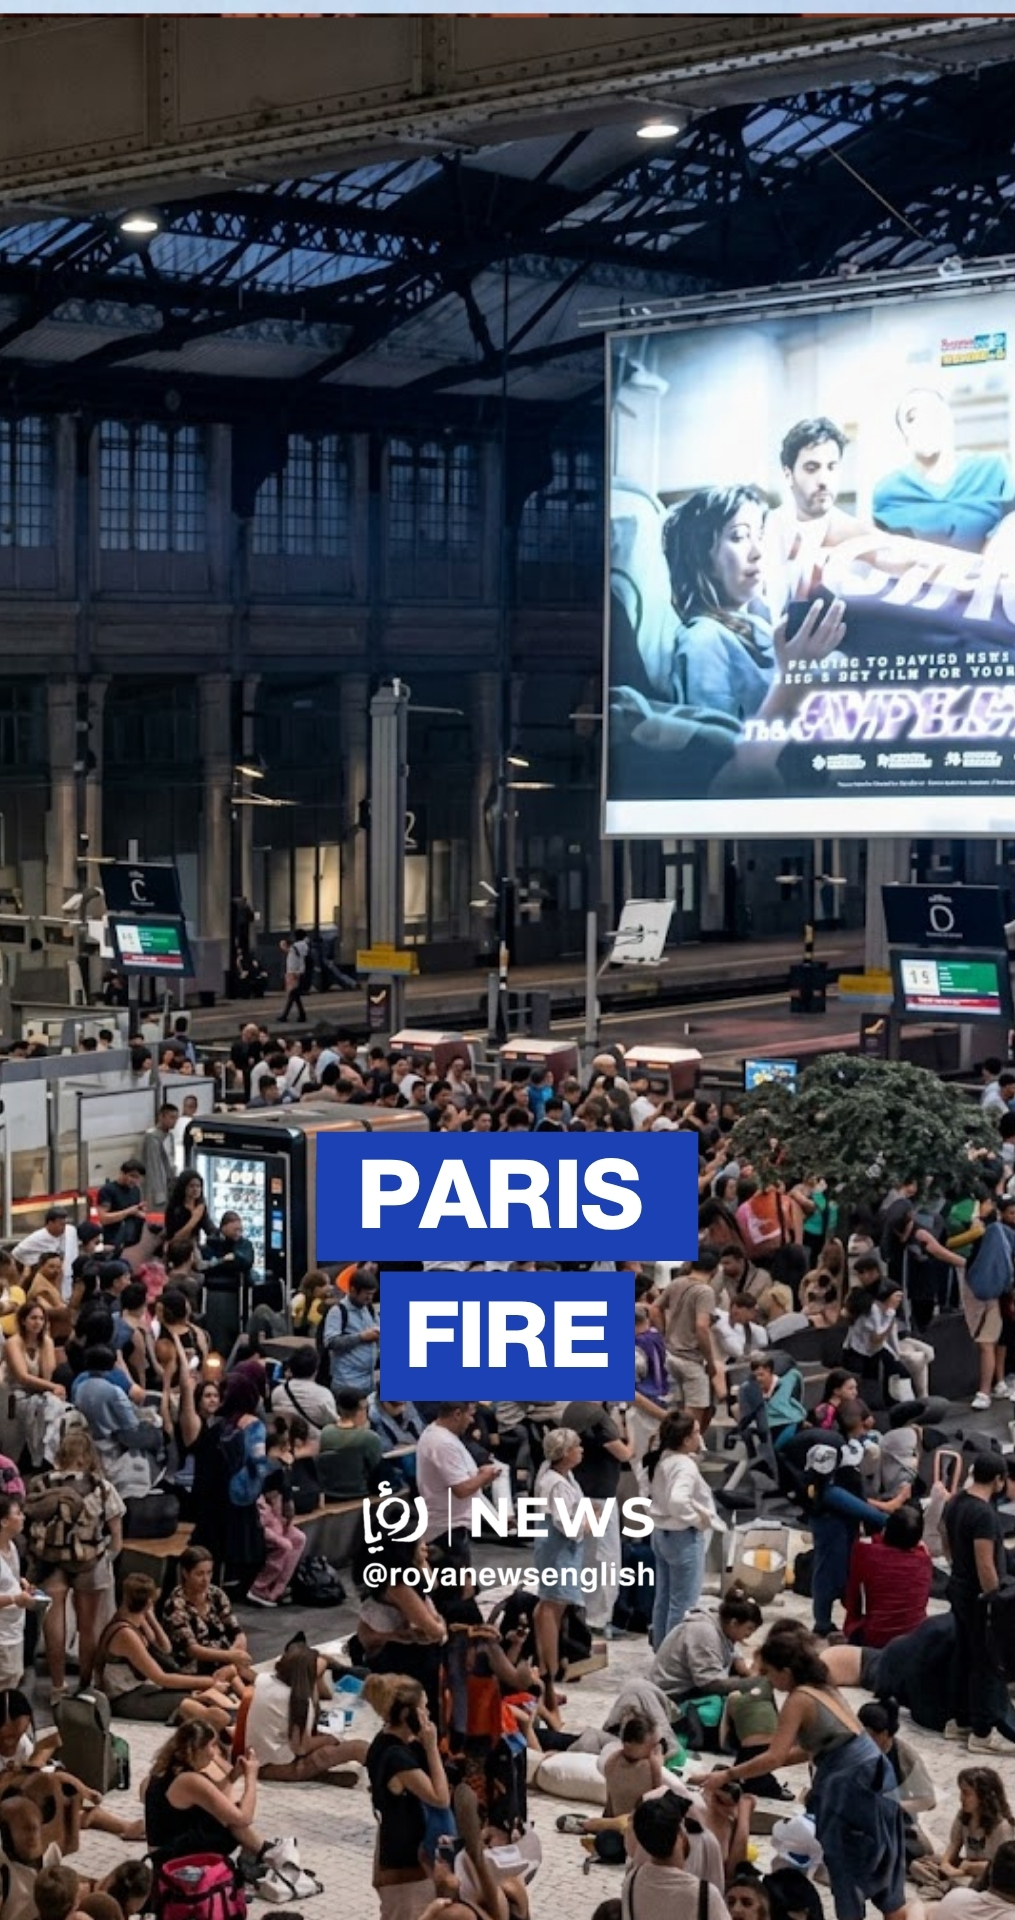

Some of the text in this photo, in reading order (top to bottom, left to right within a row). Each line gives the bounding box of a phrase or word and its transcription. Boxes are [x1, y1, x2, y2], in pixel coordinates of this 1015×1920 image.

[867, 656, 889, 668] TO
[928, 667, 962, 679] FOR
[131, 879, 147, 902] C
